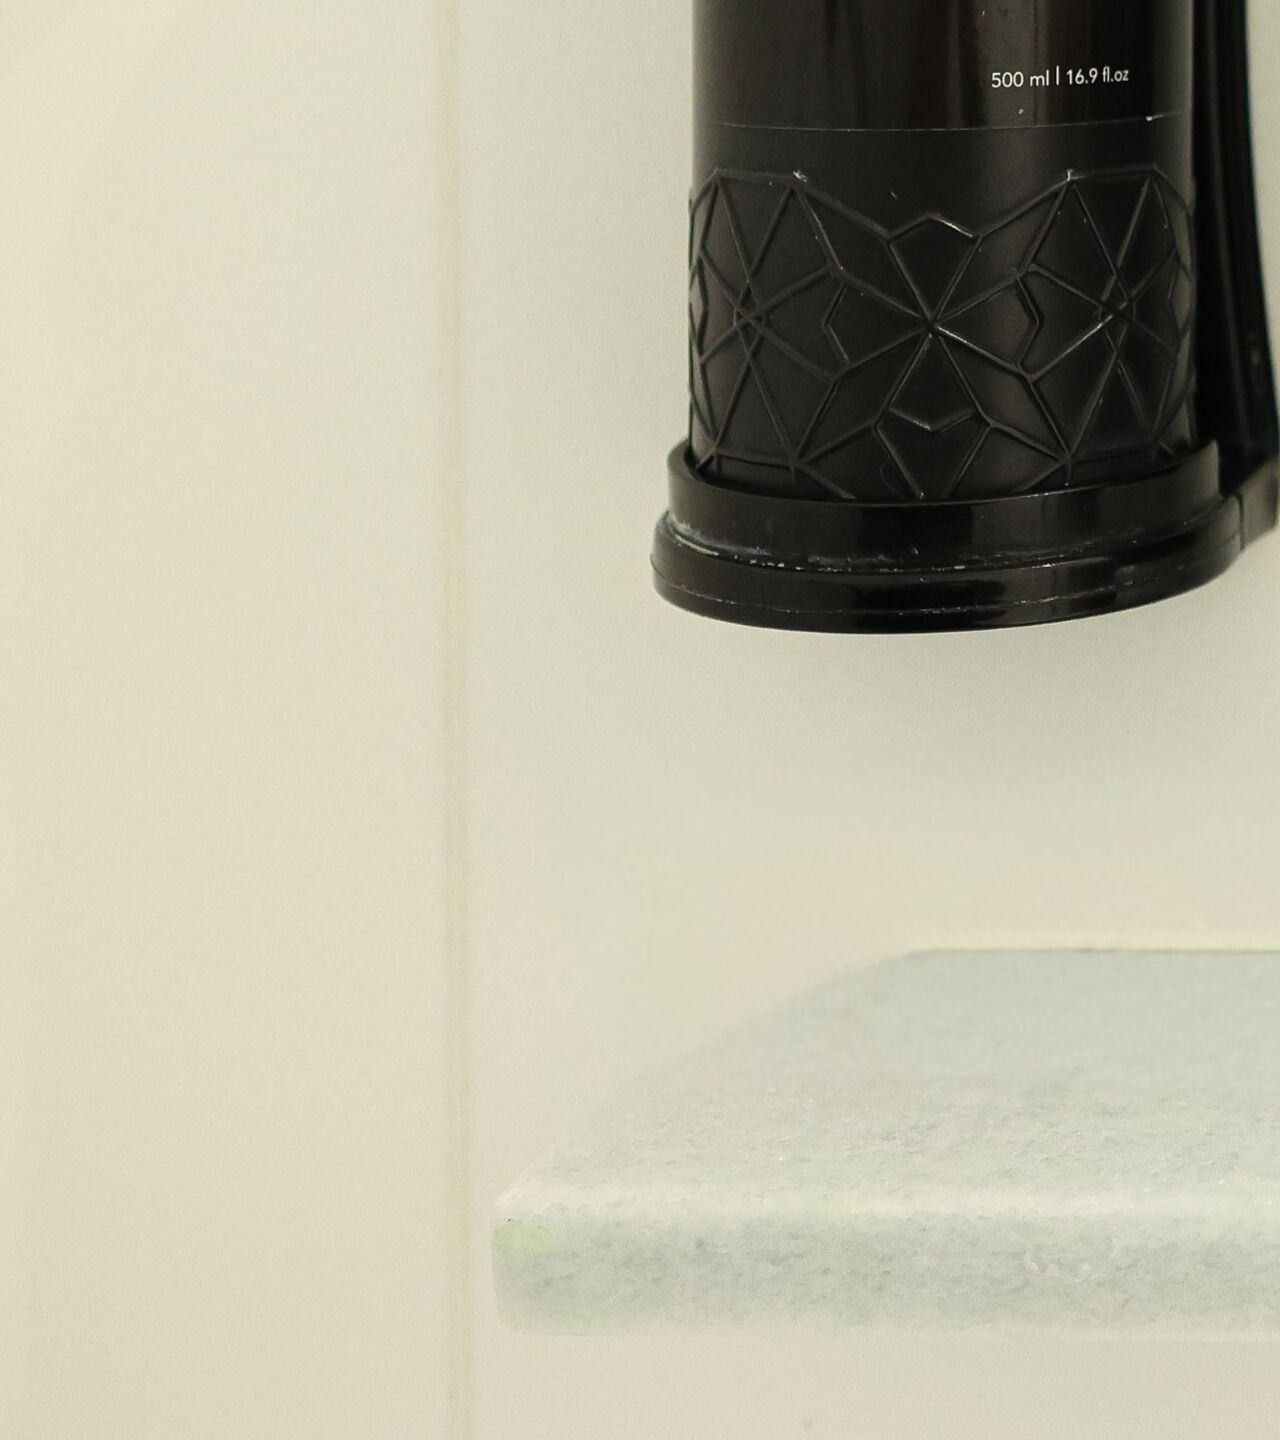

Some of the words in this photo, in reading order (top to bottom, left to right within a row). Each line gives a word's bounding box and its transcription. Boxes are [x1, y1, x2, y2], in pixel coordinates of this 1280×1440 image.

[991, 71, 1024, 88] 500
[1029, 69, 1050, 87] ml
[1066, 67, 1099, 85] 16.9
[1102, 65, 1129, 83] fl.oz
